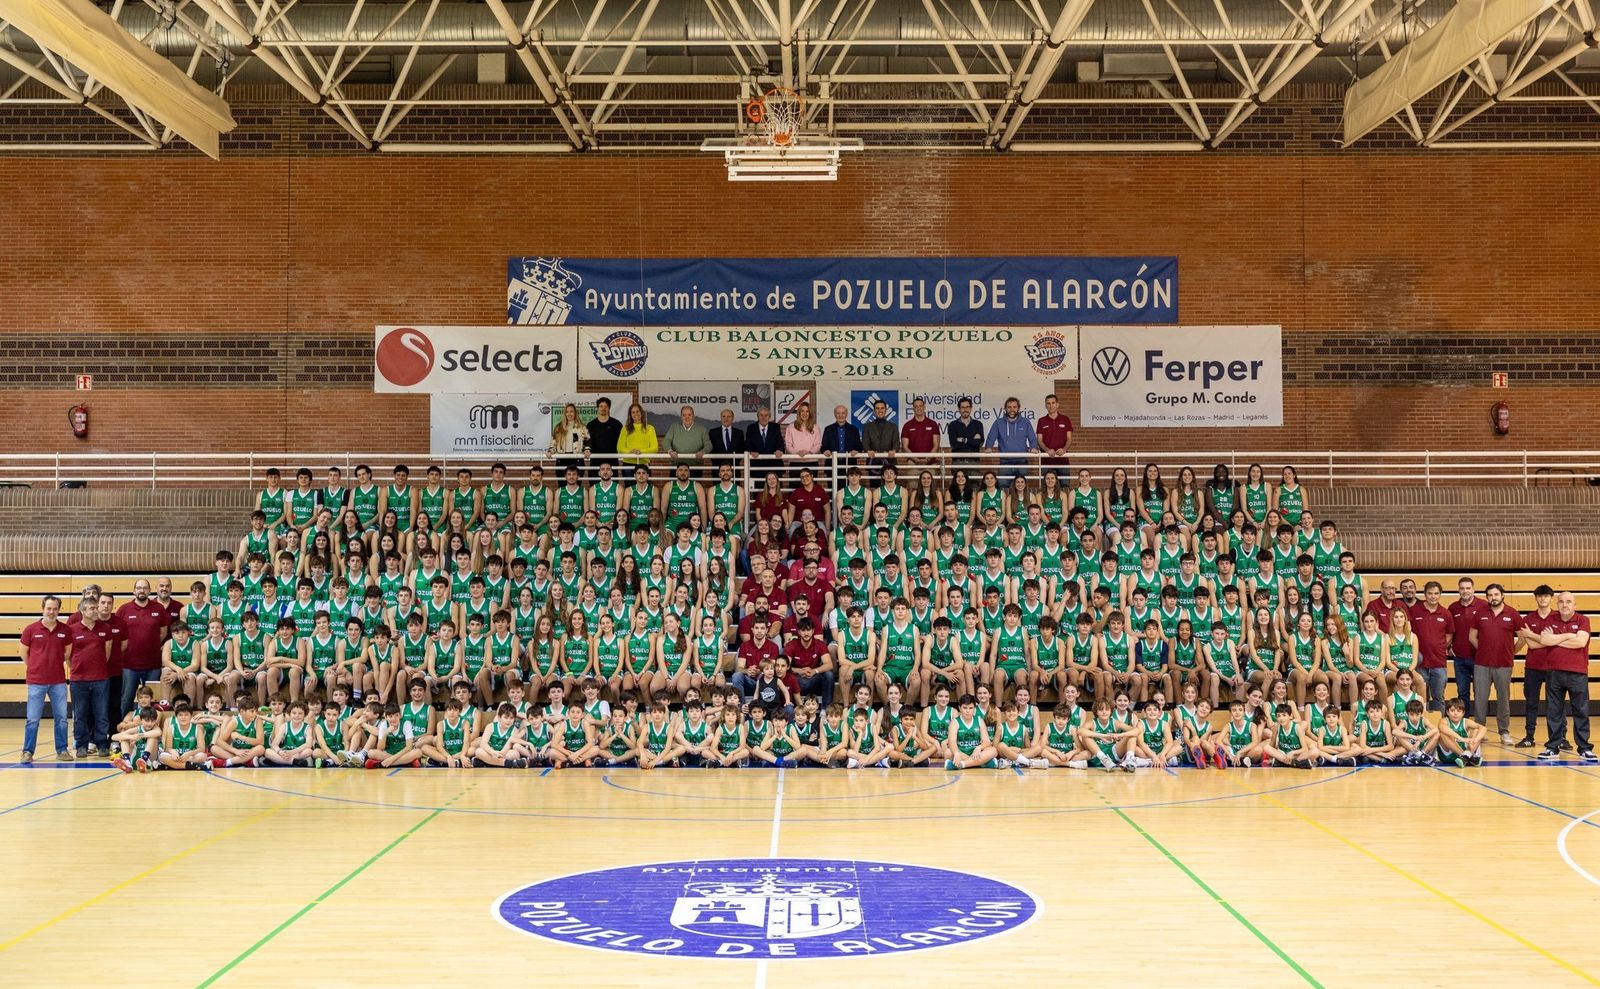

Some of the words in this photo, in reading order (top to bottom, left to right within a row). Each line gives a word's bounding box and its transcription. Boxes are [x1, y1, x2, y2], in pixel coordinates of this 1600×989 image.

[584, 286, 757, 315] Ayuntamiento
[766, 287, 796, 310] de
[812, 278, 954, 310] POZUELO
[969, 278, 1007, 310] DE
[1021, 264, 1172, 310] ALARCÓN
[656, 329, 721, 343] CLUB
[727, 329, 891, 343] BALONCESTO
[897, 329, 1013, 343] POZUELO
[440, 344, 564, 373] selecta
[590, 342, 648, 366] POZUELO
[736, 347, 761, 360] 25
[766, 347, 933, 360] ANIVERSARIO
[776, 364, 826, 377] 1993
[844, 364, 895, 377] 2018
[1144, 350, 1264, 389] Ferper
[641, 395, 726, 404] BIENVENIDOS
[726, 395, 739, 404] A
[1145, 392, 1188, 407] Grupo
[1192, 392, 1210, 404] M.
[1214, 391, 1257, 404] Conde
[905, 408, 961, 420] Fncisc
[973, 408, 991, 420] de
[1124, 414, 1166, 422] Majadahonda
[1242, 413, 1269, 422] Leganés
[454, 436, 478, 446] mm
[480, 434, 534, 446] fisioclinic
[642, 865, 856, 876] Ayuntamiento
[519, 901, 685, 951] POZUELO
[715, 942, 797, 956] DE
[831, 900, 1023, 954] ALARCÓN
